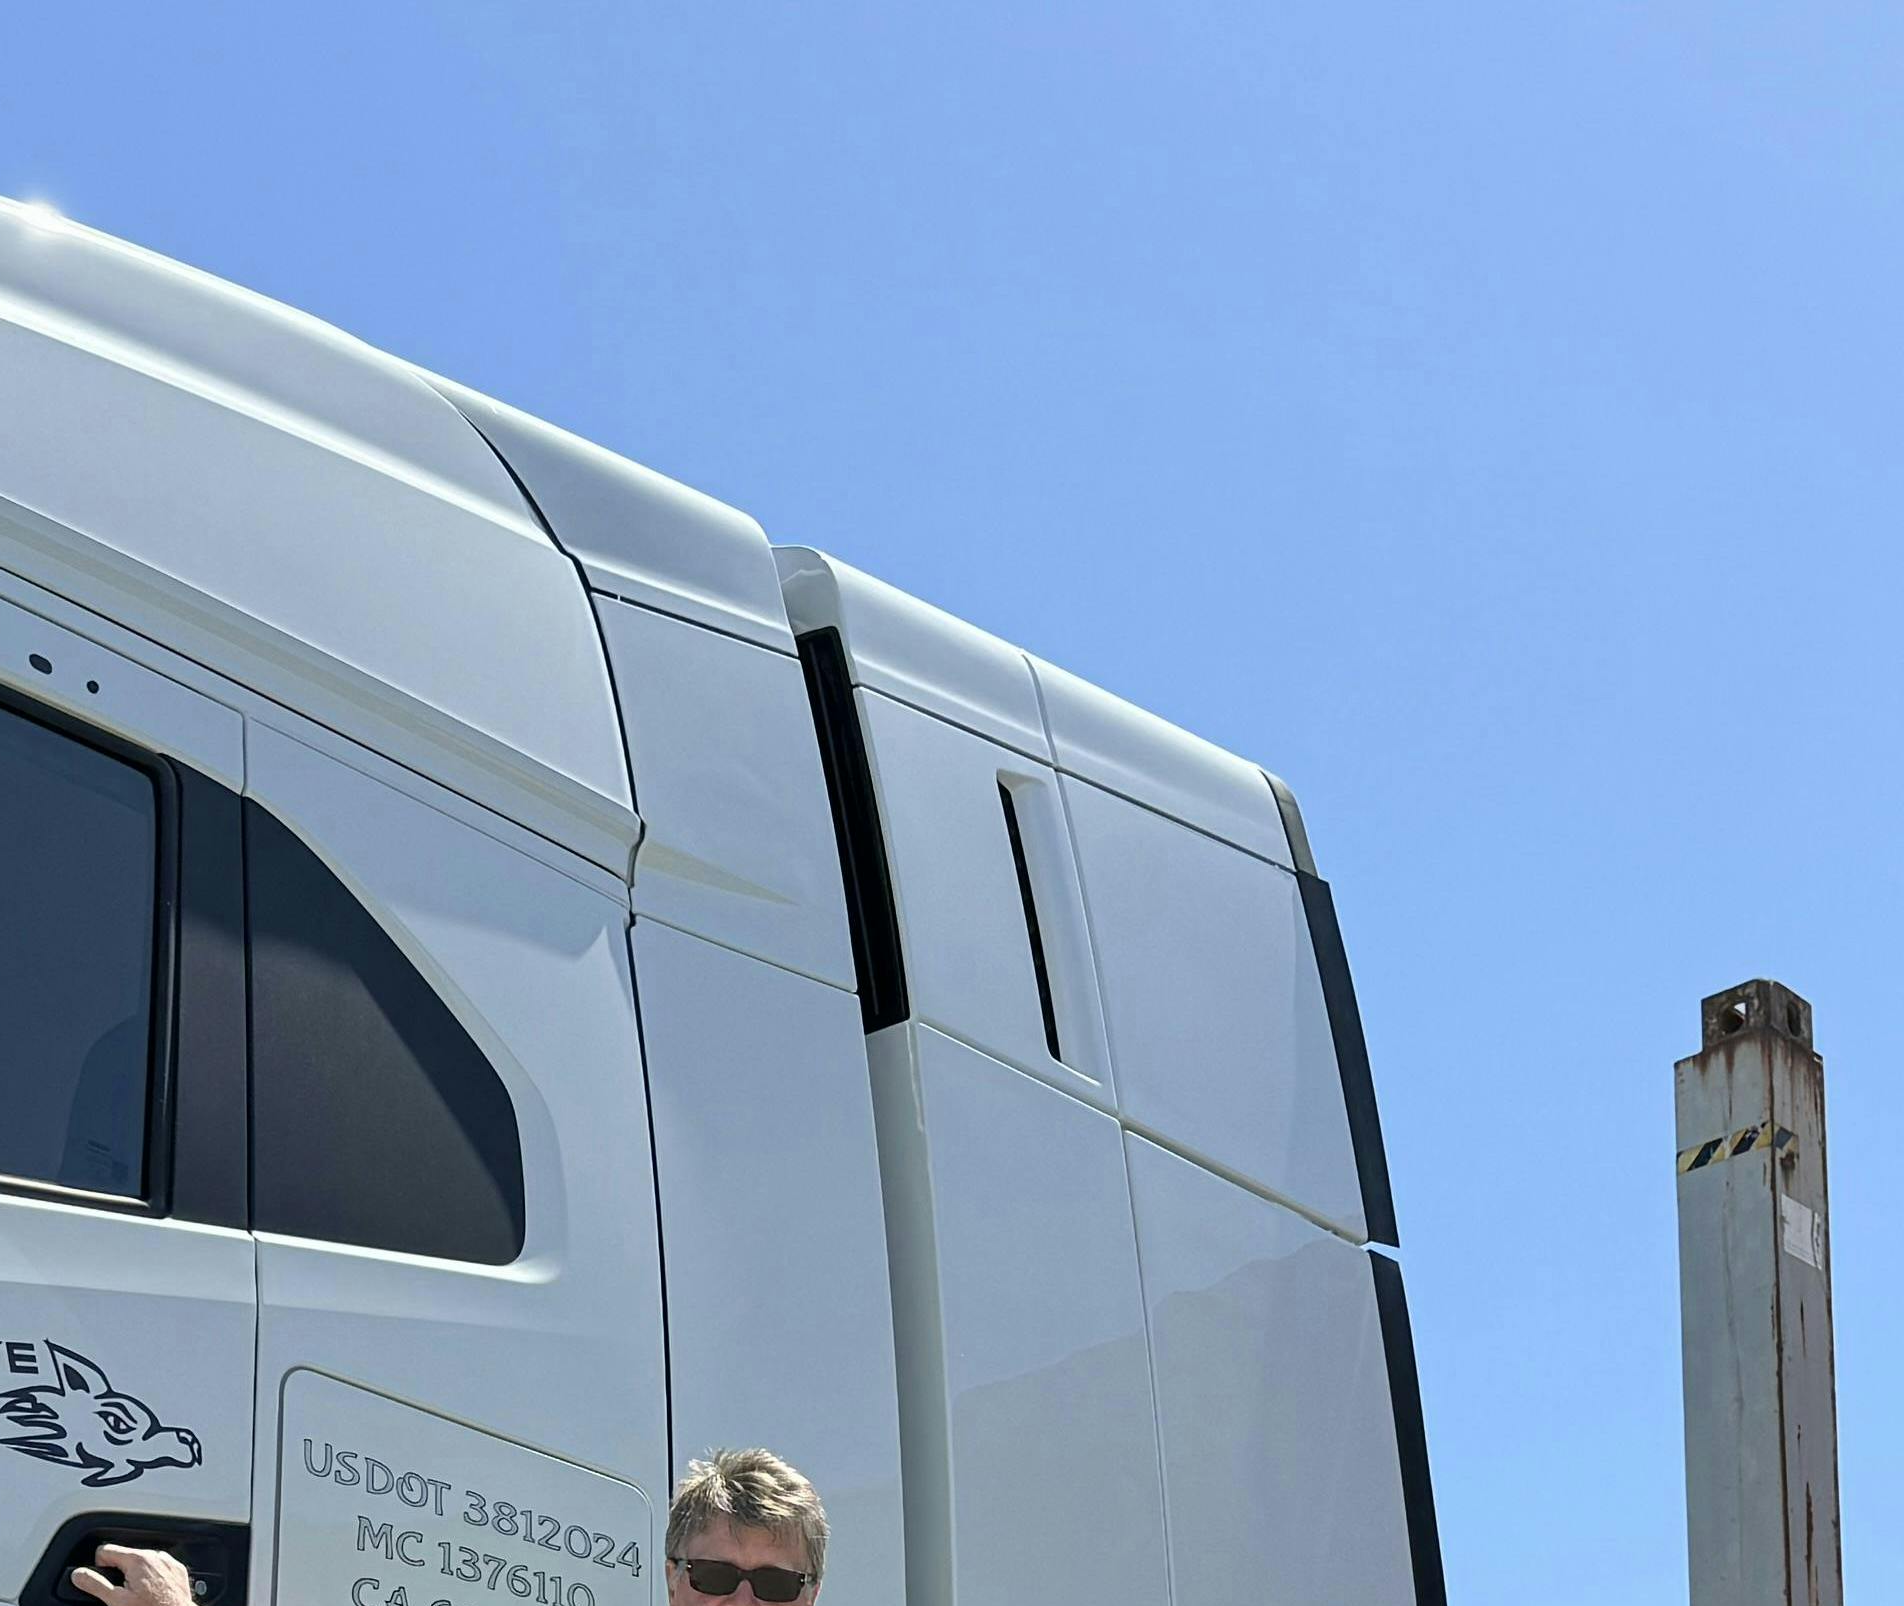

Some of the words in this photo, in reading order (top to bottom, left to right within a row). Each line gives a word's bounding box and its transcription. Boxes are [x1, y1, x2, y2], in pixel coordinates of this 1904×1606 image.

[303, 1438, 451, 1517] USDOT
[463, 1490, 643, 1578] 3812024
[357, 1515, 426, 1567] MC
